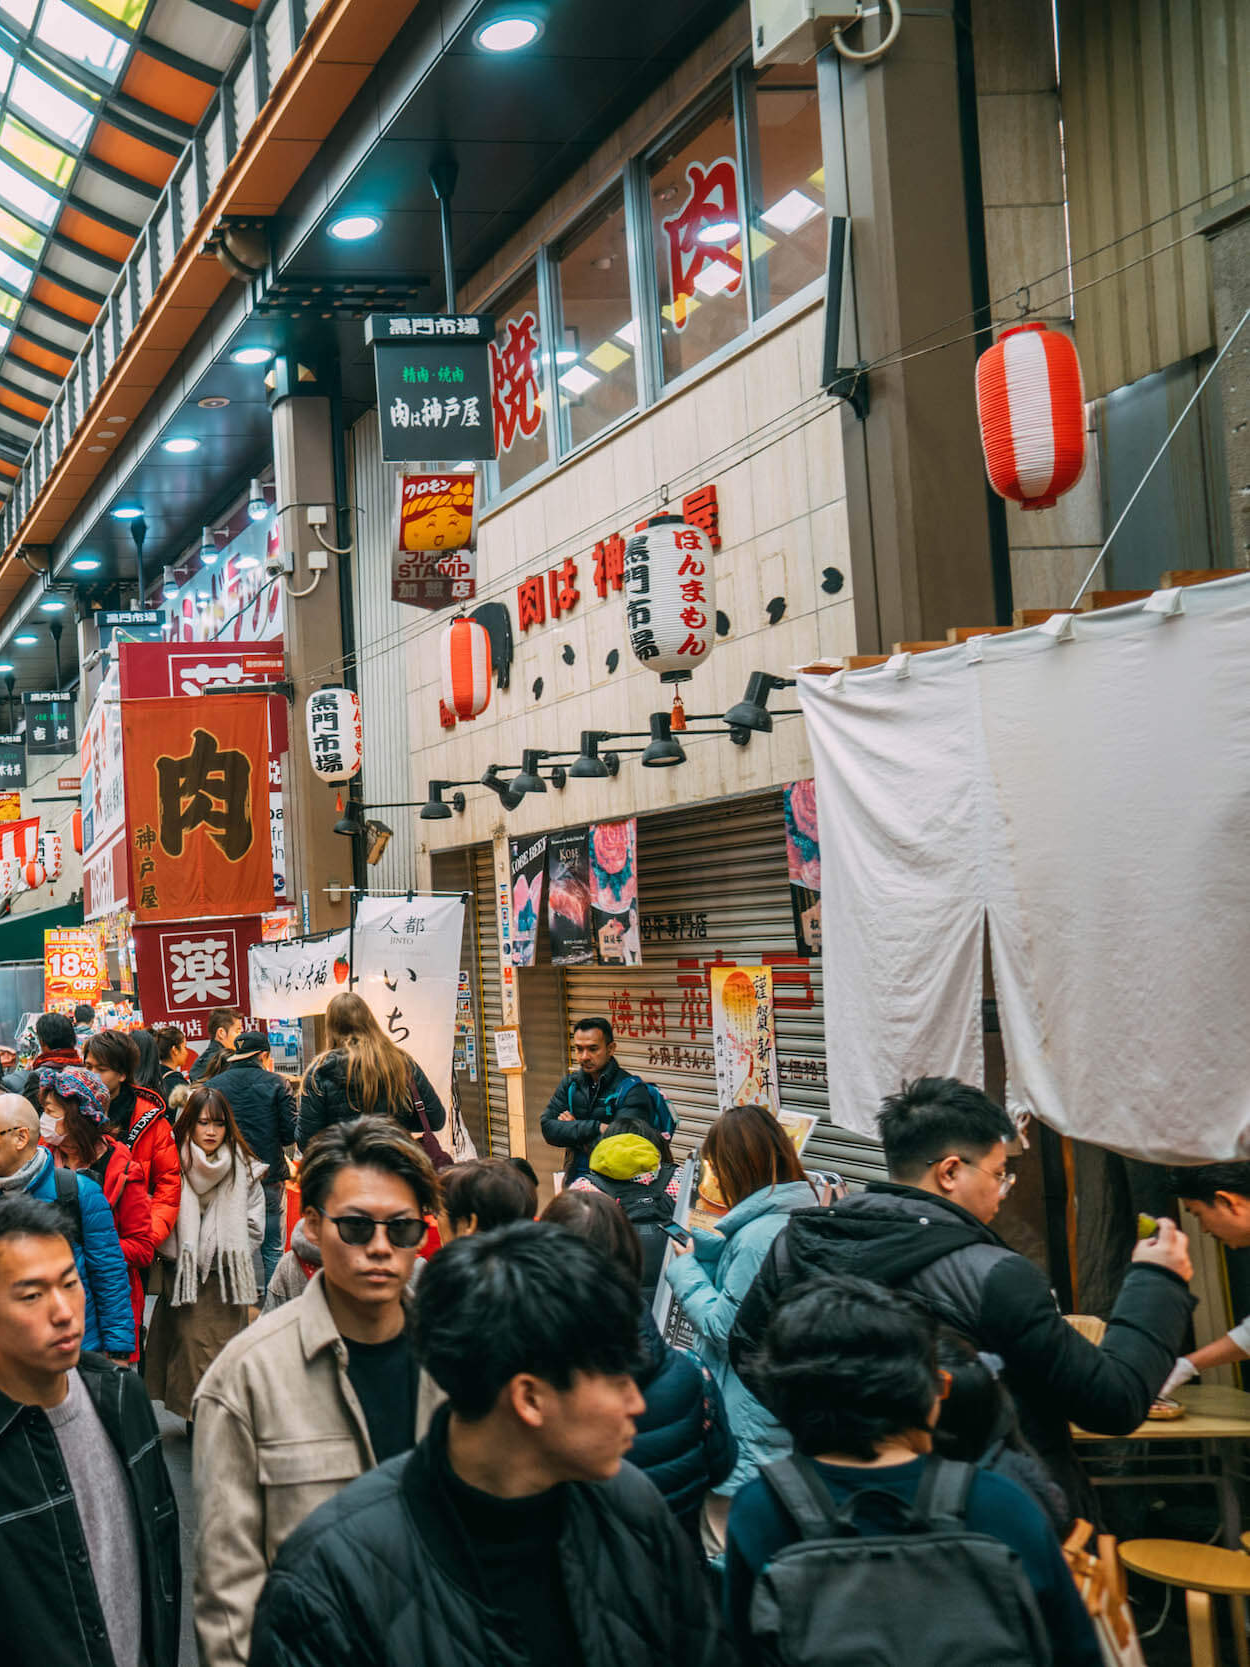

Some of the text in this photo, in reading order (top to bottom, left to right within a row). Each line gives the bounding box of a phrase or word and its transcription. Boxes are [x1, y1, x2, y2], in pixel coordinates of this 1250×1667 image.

[663, 156, 744, 333] 肉
[389, 317, 480, 335] 黒門市場
[390, 397, 481, 428] 肉は神戸屋
[405, 479, 451, 499] クロモン
[398, 564, 470, 579] STAMP
[672, 530, 708, 656] ほんまもん
[311, 692, 344, 773] 黒門市場
[154, 728, 253, 862] 肉
[133, 823, 160, 910] 神戸屋
[379, 915, 426, 936] 人都
[48, 952, 97, 977] 18%
[169, 938, 231, 1004] 薬
[73, 980, 98, 990] OFF
